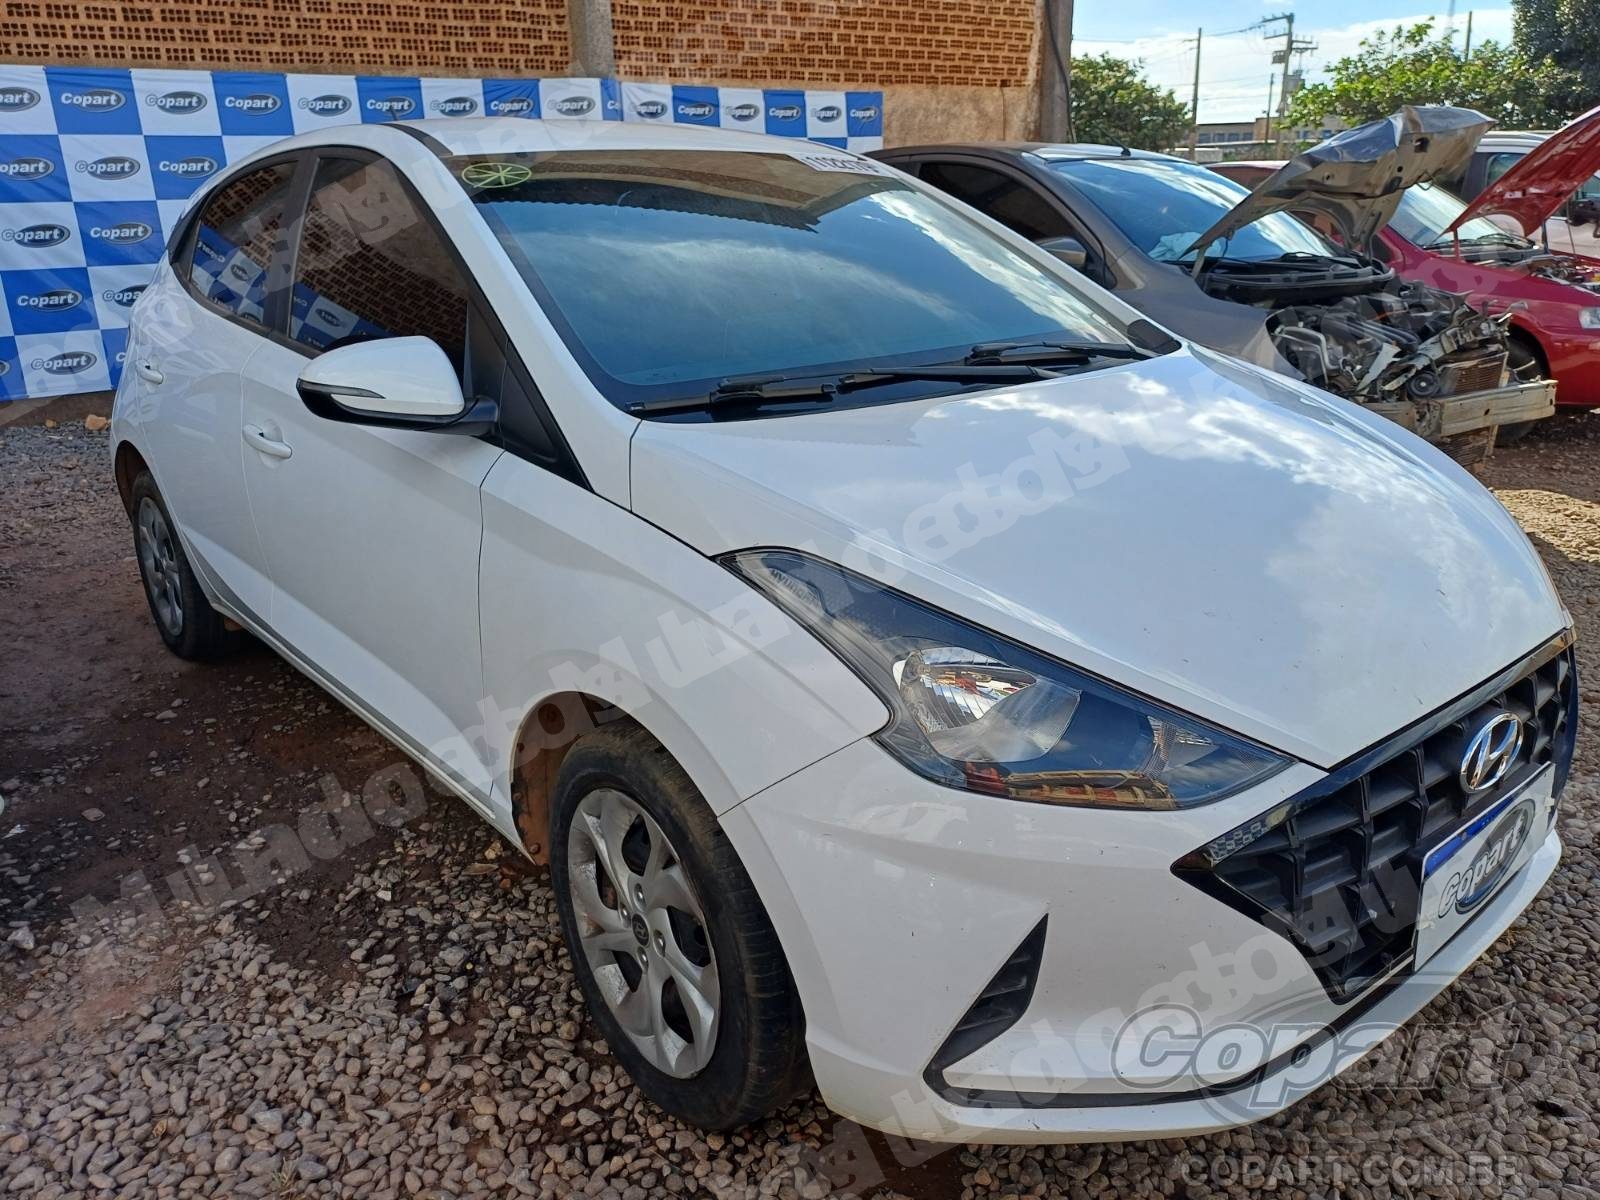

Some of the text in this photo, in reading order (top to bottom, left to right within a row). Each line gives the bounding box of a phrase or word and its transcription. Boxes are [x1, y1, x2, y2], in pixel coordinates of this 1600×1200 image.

[60, 92, 118, 107] Copart
[145, 94, 199, 108] Copart
[224, 96, 274, 110] Copart
[298, 97, 345, 111] Copart
[366, 99, 411, 112] Copart
[430, 100, 471, 112] Copart
[490, 99, 528, 112] Copart
[549, 99, 590, 112] Copart
[678, 105, 710, 117] Copart
[769, 107, 798, 119] Copart
[850, 108, 876, 119] Copart
[75, 160, 131, 174] Copart
[159, 160, 211, 174] Copart
[1, 228, 61, 242] Copart
[90, 225, 145, 239] Copart
[17, 292, 75, 307] Copart
[31, 356, 88, 371] Copart
[1438, 808, 1527, 919] Copart
